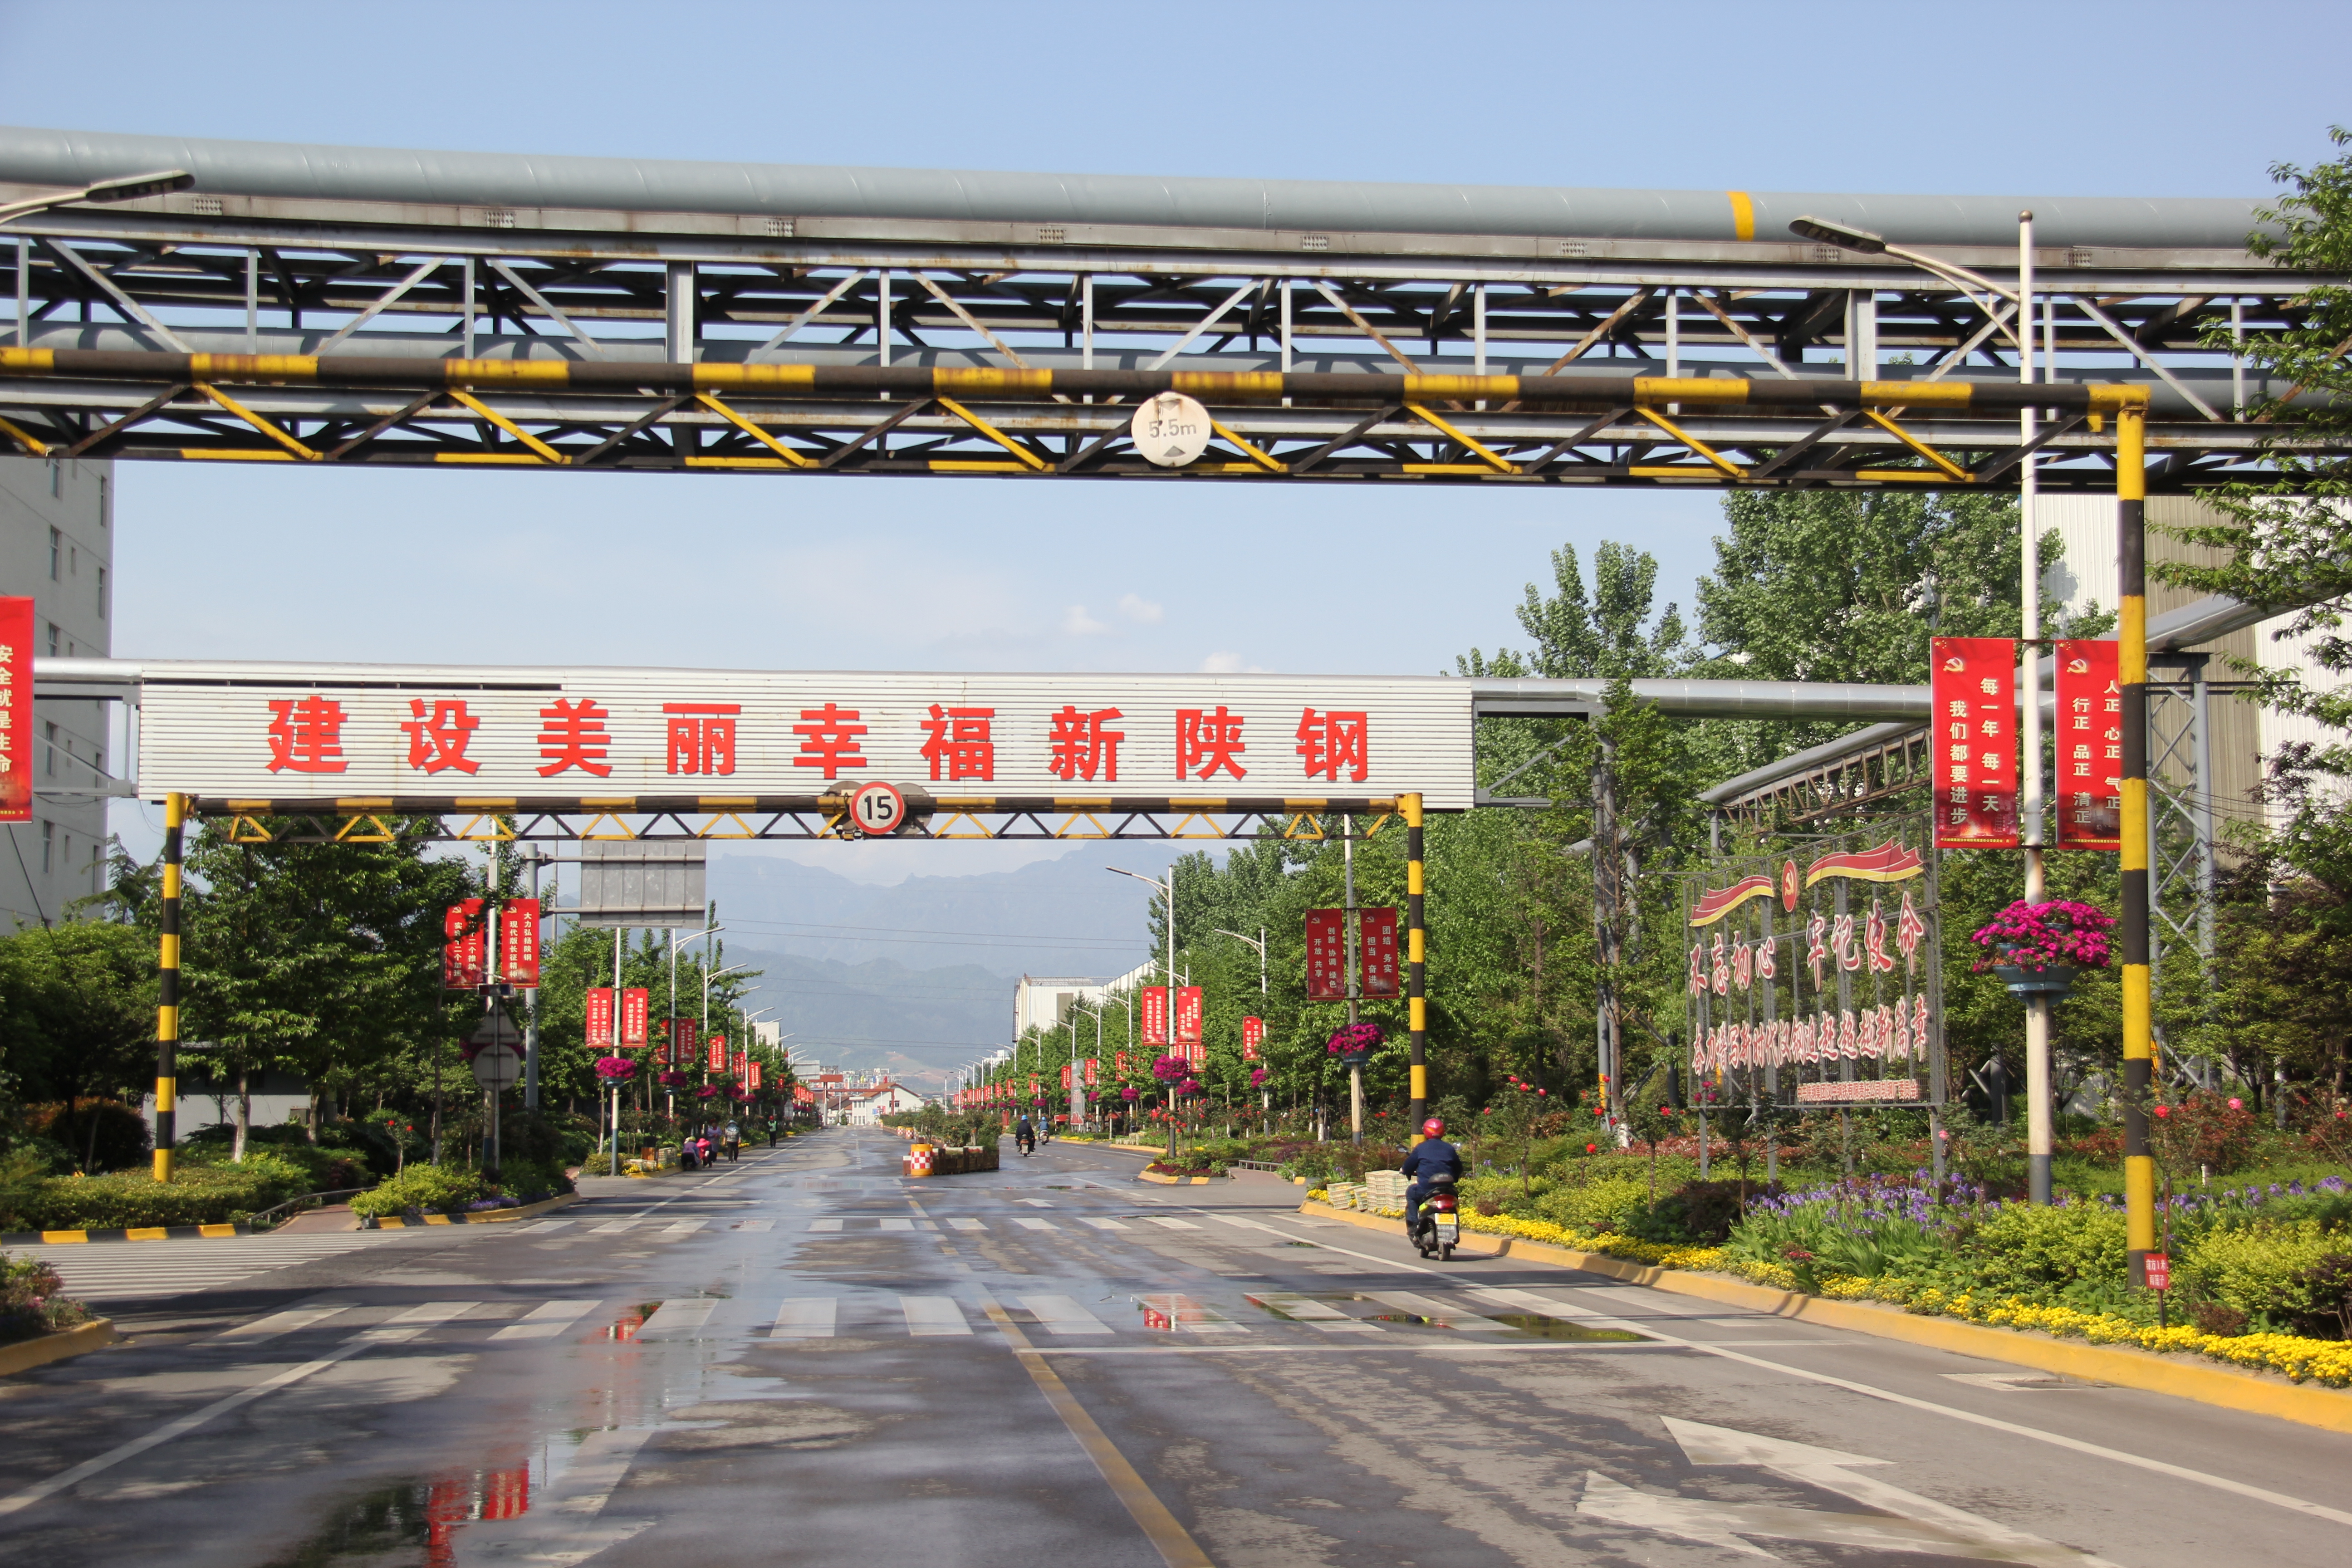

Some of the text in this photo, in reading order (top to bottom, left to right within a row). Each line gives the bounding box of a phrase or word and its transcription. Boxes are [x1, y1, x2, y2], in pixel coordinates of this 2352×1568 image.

[1148, 419, 1197, 439] 5.5m
[0, 644, 13, 772] 安全就是生命
[265, 696, 1369, 782] 建设美丽幸福新陕钢
[1949, 700, 1968, 825] 我们都要进步
[1980, 678, 1999, 812] 每一年 每一天
[2072, 698, 2091, 824] 行正 品正 清正
[2103, 680, 2121, 809] 人正 心正 气正
[864, 795, 893, 820] 15
[468, 913, 476, 970] 二个推动
[510, 921, 518, 978] 现代版长征精神
[524, 912, 532, 961] 大力弘扬陕钢
[1314, 938, 1323, 977] 开放 共享
[1328, 927, 1337, 988] 创新 协调 绿色
[1367, 936, 1377, 984] 担当 奋进
[1382, 926, 1392, 973] 团结 务实
[1689, 891, 1926, 999] 不忘初心 牢记使命
[1691, 992, 1930, 1077] 奋力谱写新时代汉钢追赶超越新篇章
